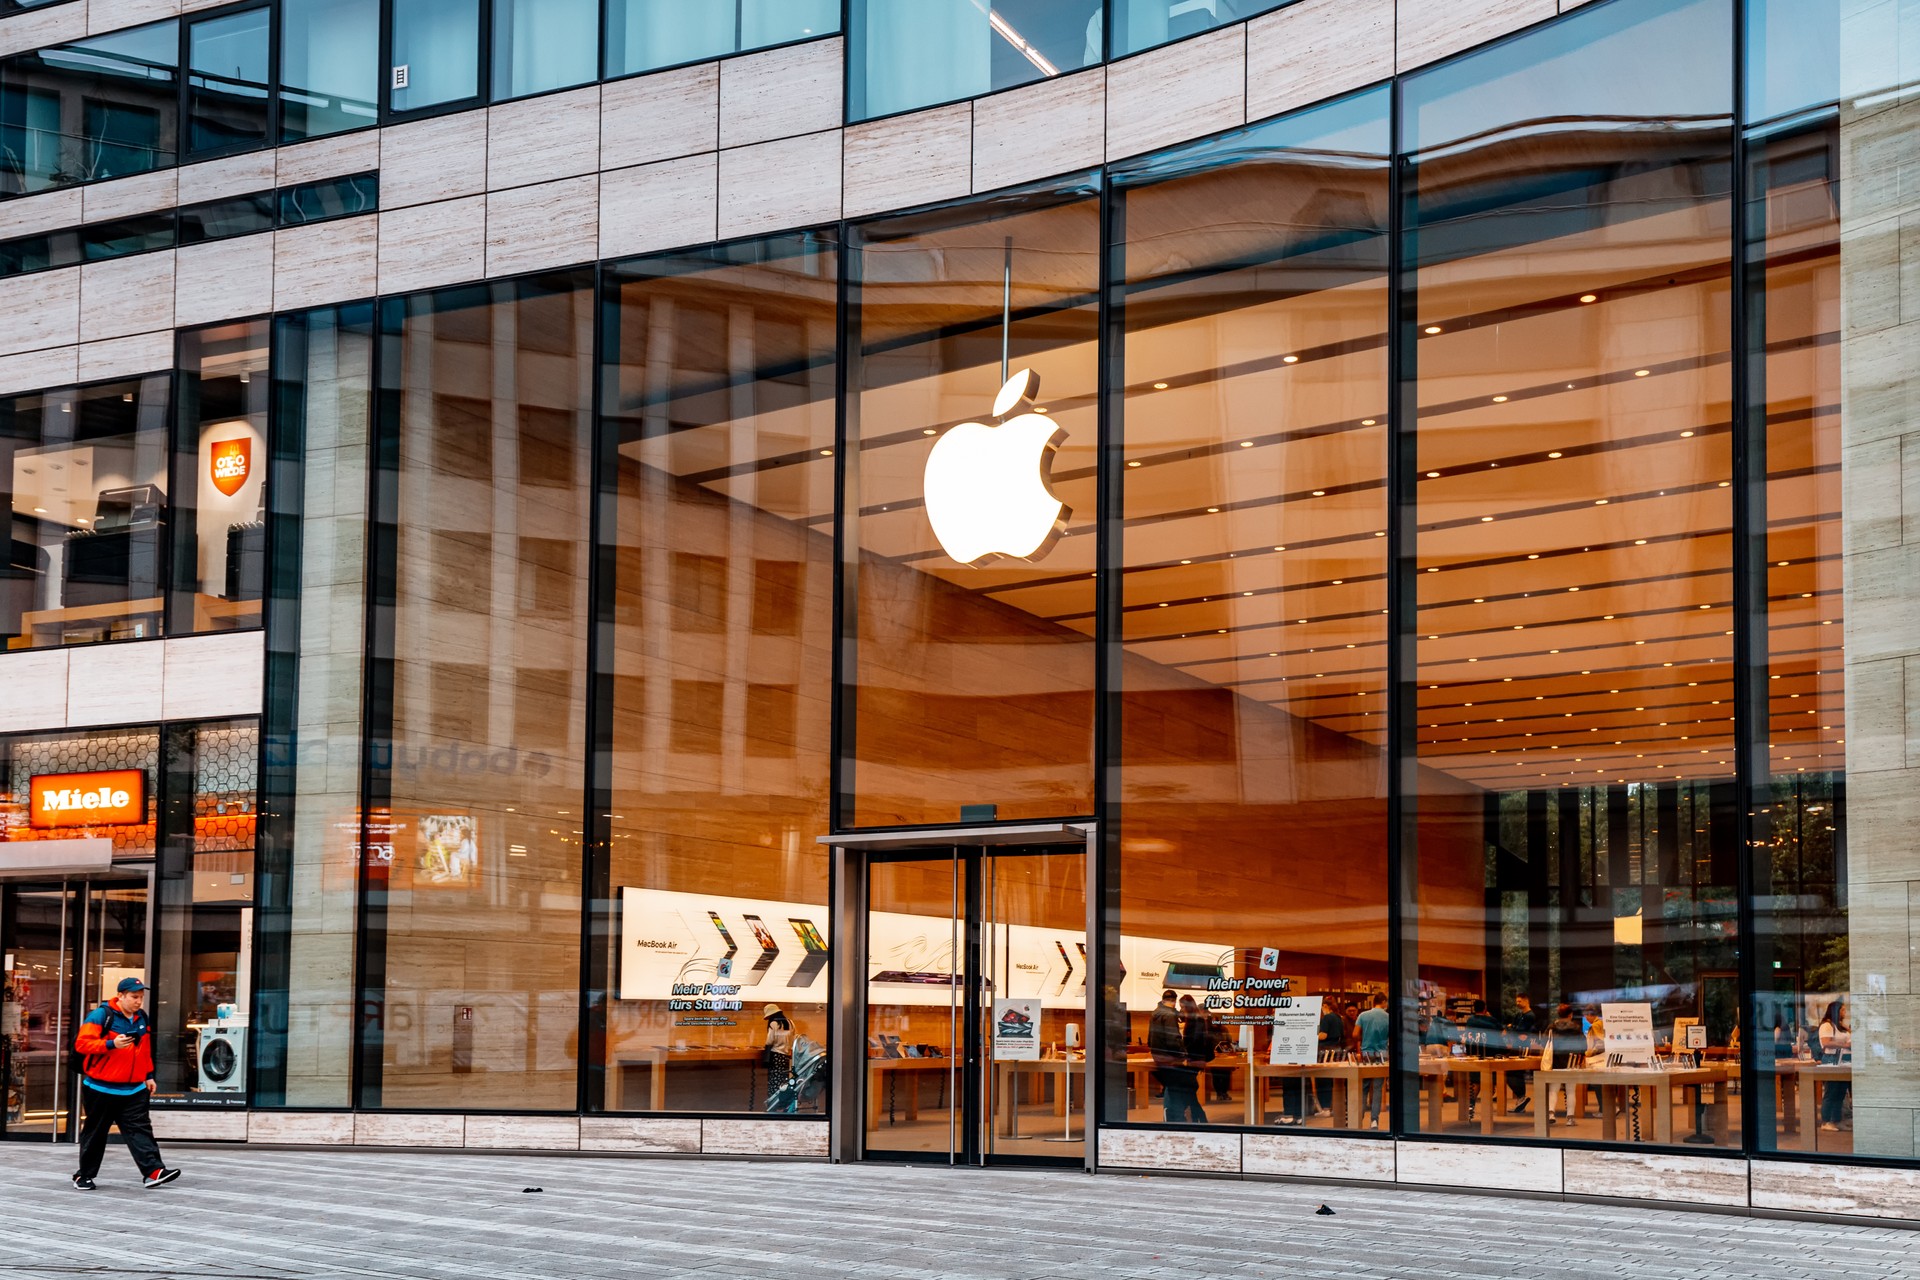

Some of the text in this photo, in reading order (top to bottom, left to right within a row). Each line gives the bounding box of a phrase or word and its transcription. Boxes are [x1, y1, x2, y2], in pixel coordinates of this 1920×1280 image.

[42, 787, 130, 811] Miele
[637, 940, 678, 949] MacBook Air
[672, 984, 741, 995] Mehr Power
[1208, 977, 1243, 990] Mehr
[1246, 977, 1289, 990] Power
[669, 998, 743, 1011] fürs Studium
[1205, 994, 1293, 1008] fürs Studium
